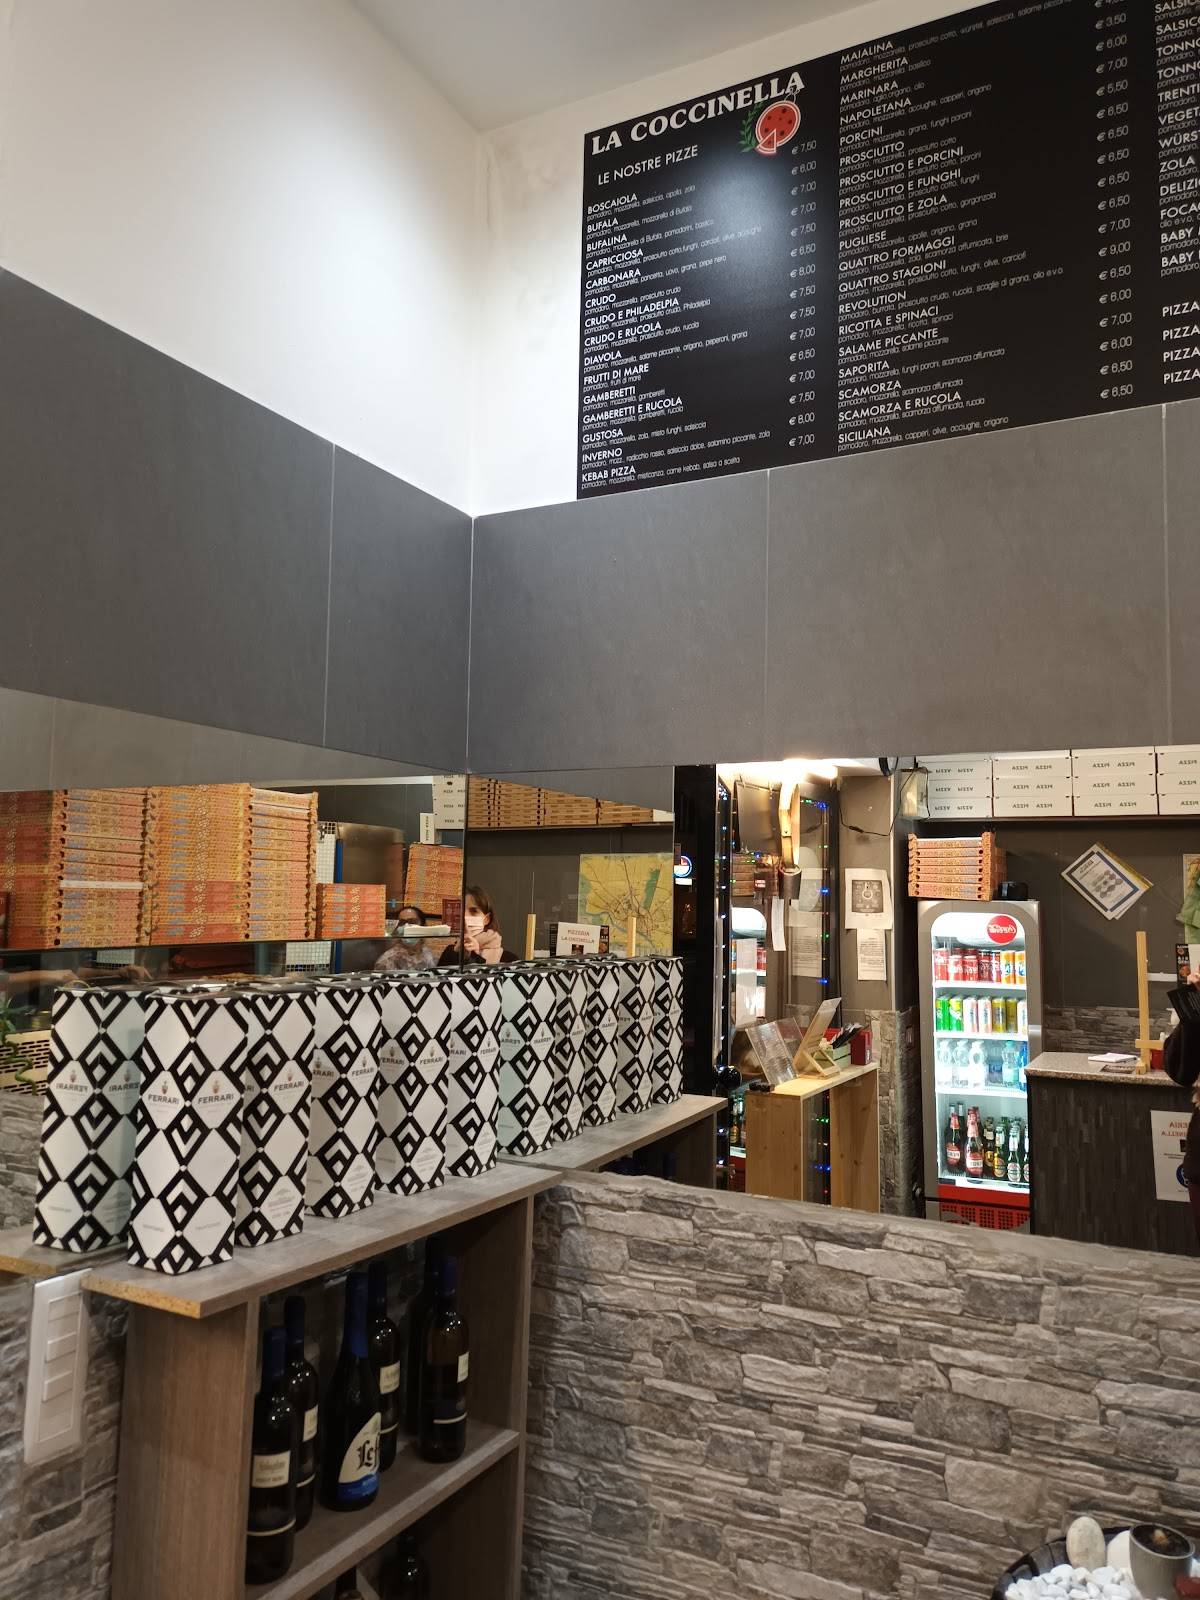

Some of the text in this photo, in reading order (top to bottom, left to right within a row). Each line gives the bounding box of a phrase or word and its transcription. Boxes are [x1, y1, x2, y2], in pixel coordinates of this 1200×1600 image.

[1095, 20, 1104, 29] €
[840, 40, 892, 64] MAIALINA
[840, 56, 907, 84] MARGHERITA
[1096, 64, 1104, 73] €
[840, 80, 898, 105] MARINARA
[1096, 86, 1105, 96] €
[592, 71, 805, 155] LA COCCINELLA
[840, 97, 911, 125] NAPOLETANA
[1158, 106, 1200, 125] VEGET
[839, 127, 882, 146] PORCINI
[839, 142, 904, 167] PROSCIUTTO
[1097, 155, 1106, 164] €
[598, 145, 698, 185] LE NOSTRE PIZZE
[839, 147, 962, 188] PROSCIUTTO E PORCINI
[1159, 156, 1195, 173] ZOLA
[791, 187, 798, 195] €
[839, 169, 960, 208] PROSCIUTTO E FUNGHI
[1160, 178, 1200, 196] DELIZI
[587, 193, 637, 213] BOSCAIOLA
[839, 194, 947, 229] PROSCIUTTO E ZOLA
[1160, 201, 1200, 220] FOCA
[587, 217, 618, 232] BUFALA
[586, 234, 627, 251] BUFALINA
[839, 231, 885, 250] PUGLIESE
[1161, 227, 1194, 244] BABY
[585, 248, 643, 270] CAPRICCIOSA
[838, 236, 954, 272] QUATTRO FORMAGGI
[1098, 248, 1107, 257] €
[1161, 251, 1194, 268] BABY
[585, 268, 641, 289] CARBONARA
[790, 269, 797, 277] €
[838, 260, 945, 293] QUATTRO STAGIONI
[585, 294, 616, 308] CRUDO
[839, 291, 905, 314] REVOLUTION
[1162, 301, 1200, 317] PIZZA
[584, 297, 679, 327] CRUDO E PHILADELPIA
[790, 311, 797, 319] €
[839, 306, 938, 335] RICOTTA E SPINACI
[1099, 318, 1108, 327] €
[584, 321, 661, 346] CRUDO E RUCOLA
[1163, 324, 1200, 341] PIZZA
[838, 328, 937, 356] SALAME PICCANTE
[584, 350, 621, 365] DIAVOLA
[1163, 346, 1200, 362] PIZZA
[583, 364, 648, 384] FRUTTI DI MARE
[789, 374, 797, 382] €
[838, 360, 889, 378] SAPORITA
[1163, 368, 1200, 385] PIZZA
[583, 386, 635, 404] GAMBERETTI
[838, 380, 901, 399] SCAMORZA
[582, 396, 682, 423] GAMBERETTI E RUCOLA
[838, 391, 961, 421] SCAMORZA E RUCOLA
[582, 428, 623, 442] GUSTOSA
[789, 438, 796, 446] €
[838, 426, 890, 442] SICILIANA
[582, 448, 622, 462] INVERNO
[582, 465, 635, 481] KEBAB PIZZA
[274, 1081, 304, 1092] FERRARI
[148, 1094, 179, 1105] FERRARI
[198, 1094, 234, 1104] FERRARI
